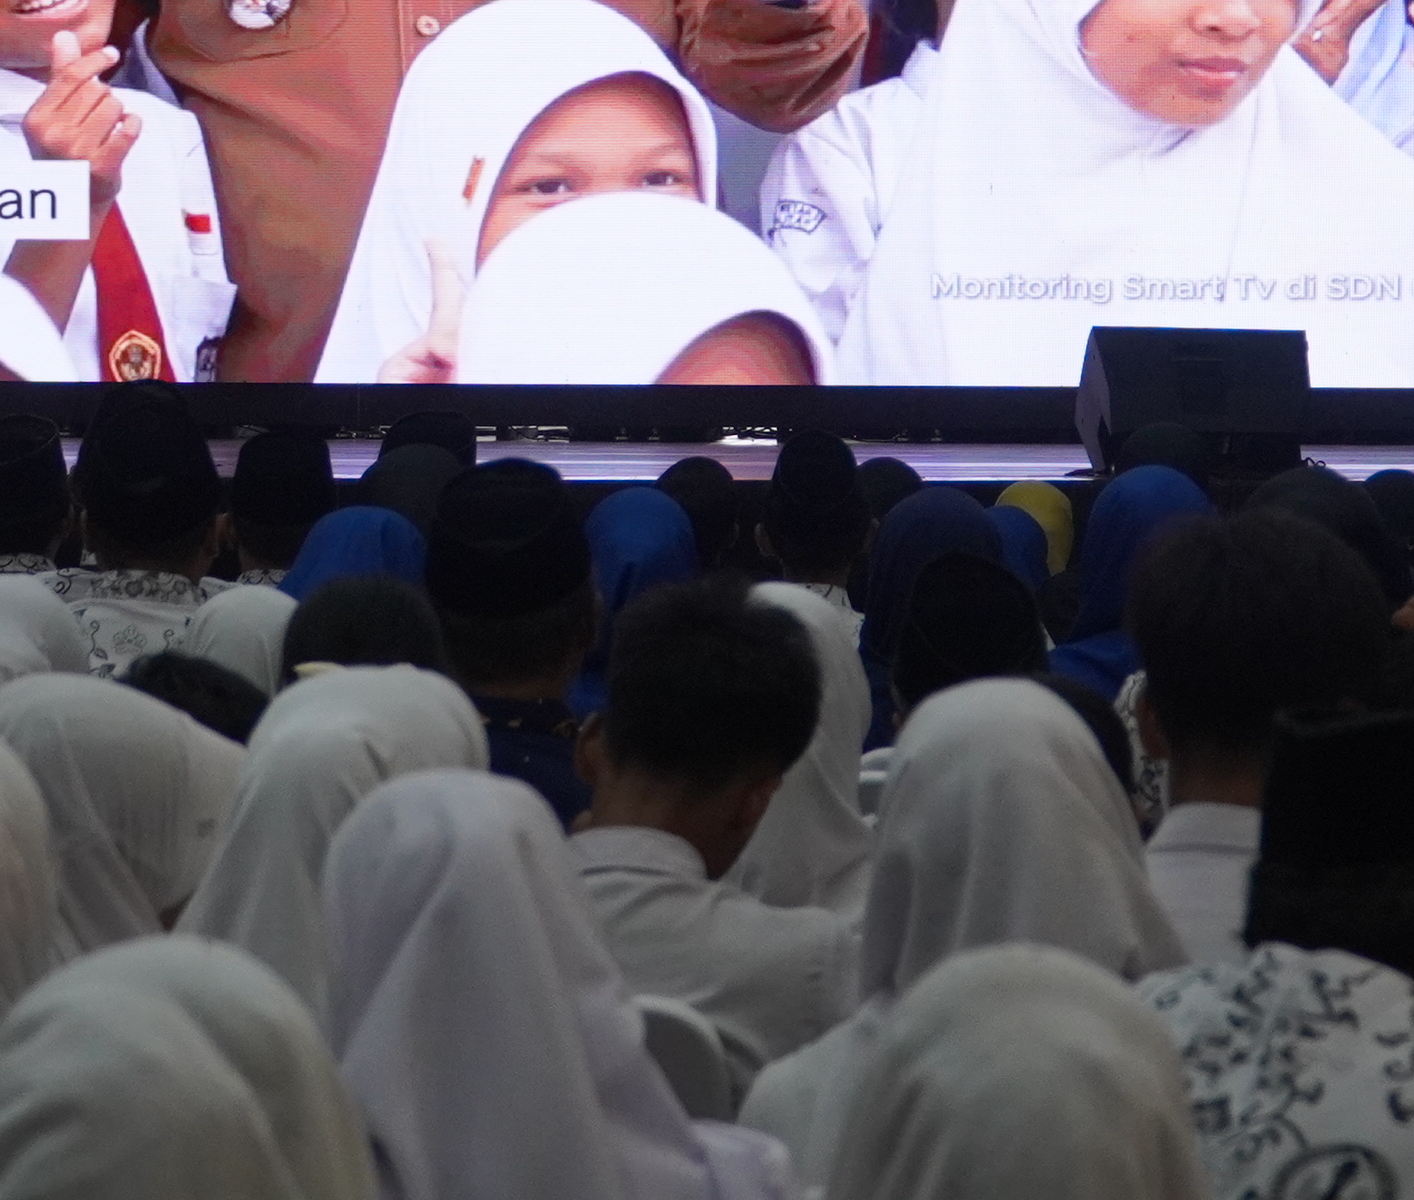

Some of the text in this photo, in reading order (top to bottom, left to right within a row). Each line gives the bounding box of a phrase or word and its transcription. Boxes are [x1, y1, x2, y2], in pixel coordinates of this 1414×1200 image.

[931, 273, 1114, 304] Monitoring
[1123, 273, 1225, 300] Smart
[1233, 274, 1277, 300] Tv
[1286, 273, 1317, 300] di
[1327, 274, 1402, 300] SDN
